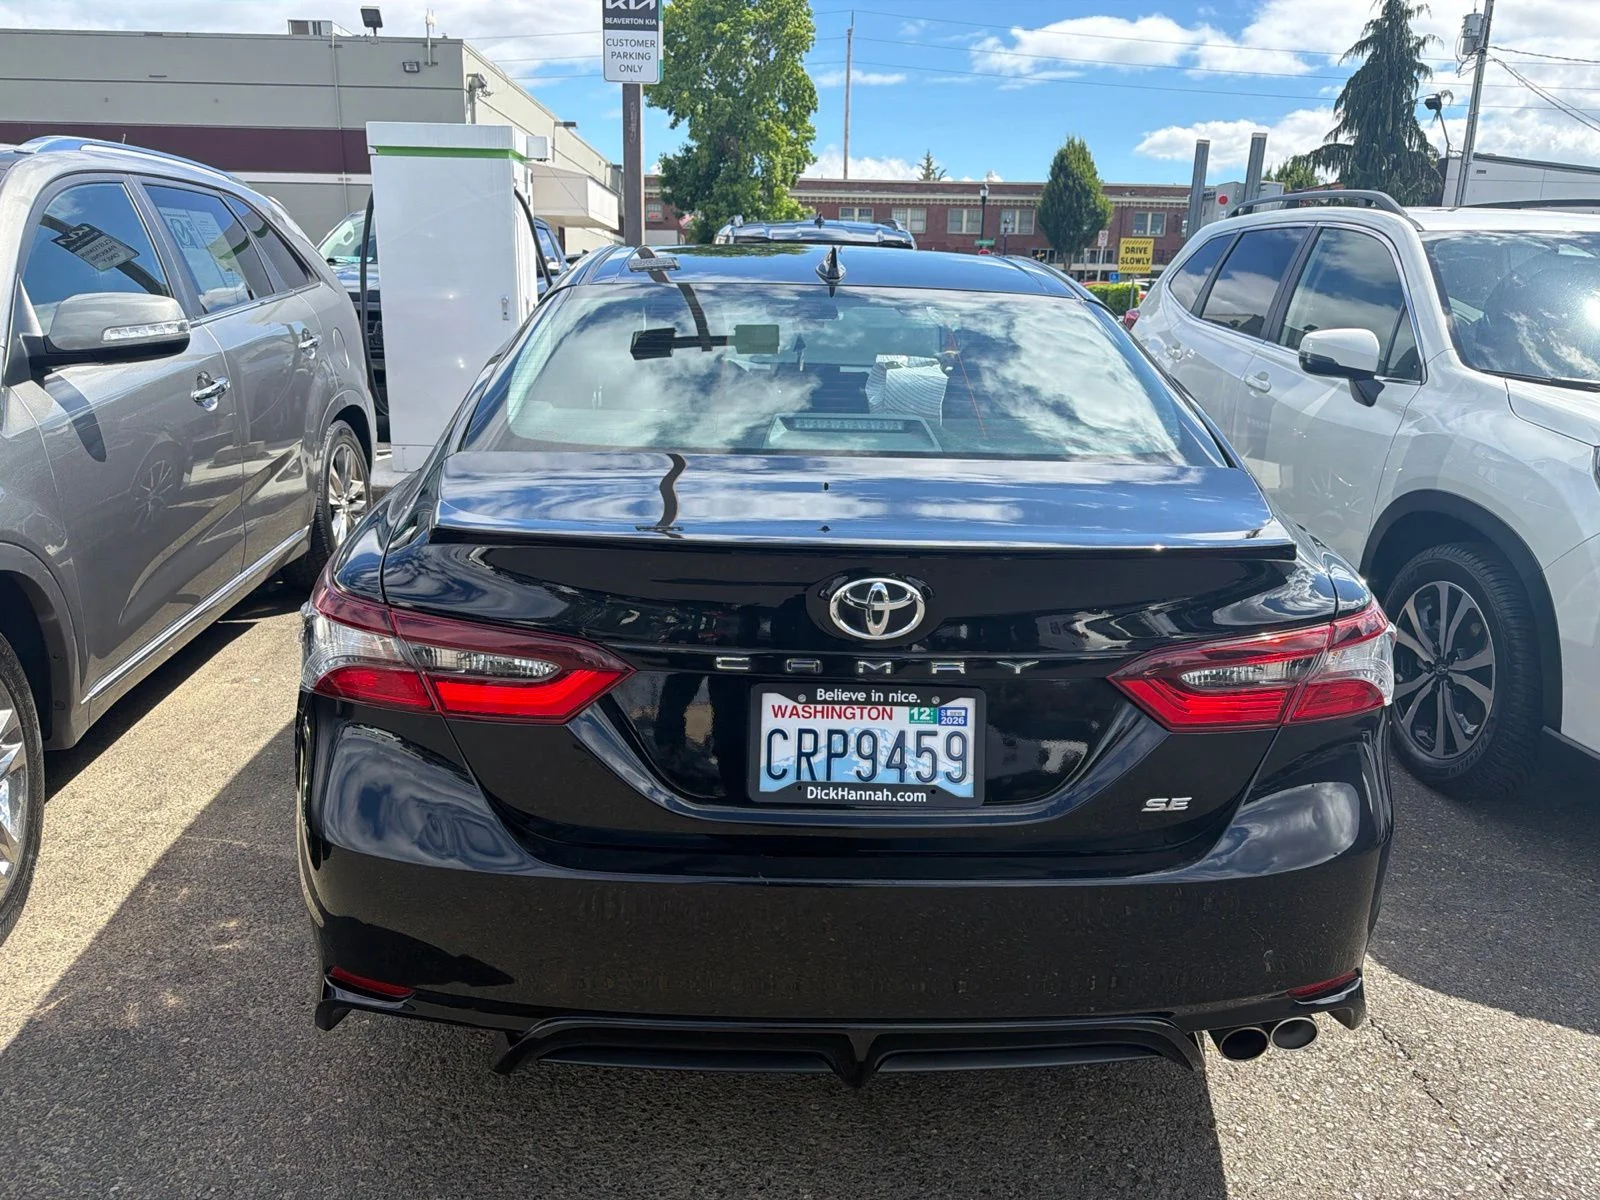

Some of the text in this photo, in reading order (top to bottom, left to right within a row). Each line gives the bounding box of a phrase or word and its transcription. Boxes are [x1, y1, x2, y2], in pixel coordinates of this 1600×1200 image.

[604, 17, 644, 25] BEAVERTON
[606, 38, 656, 48] CUSTOMER
[610, 51, 651, 61] PARKING
[618, 64, 643, 73] ONLY
[1124, 246, 1148, 255] DRIVE
[1120, 257, 1150, 265] SLOWLY
[816, 688, 921, 704] Believe in nice.
[771, 704, 893, 721] WASHINGTON
[910, 707, 931, 720] 12
[940, 717, 965, 725] 2026
[766, 728, 968, 783] CRP9459
[806, 786, 927, 803] DickHannah.com
[1141, 796, 1193, 812] SE
